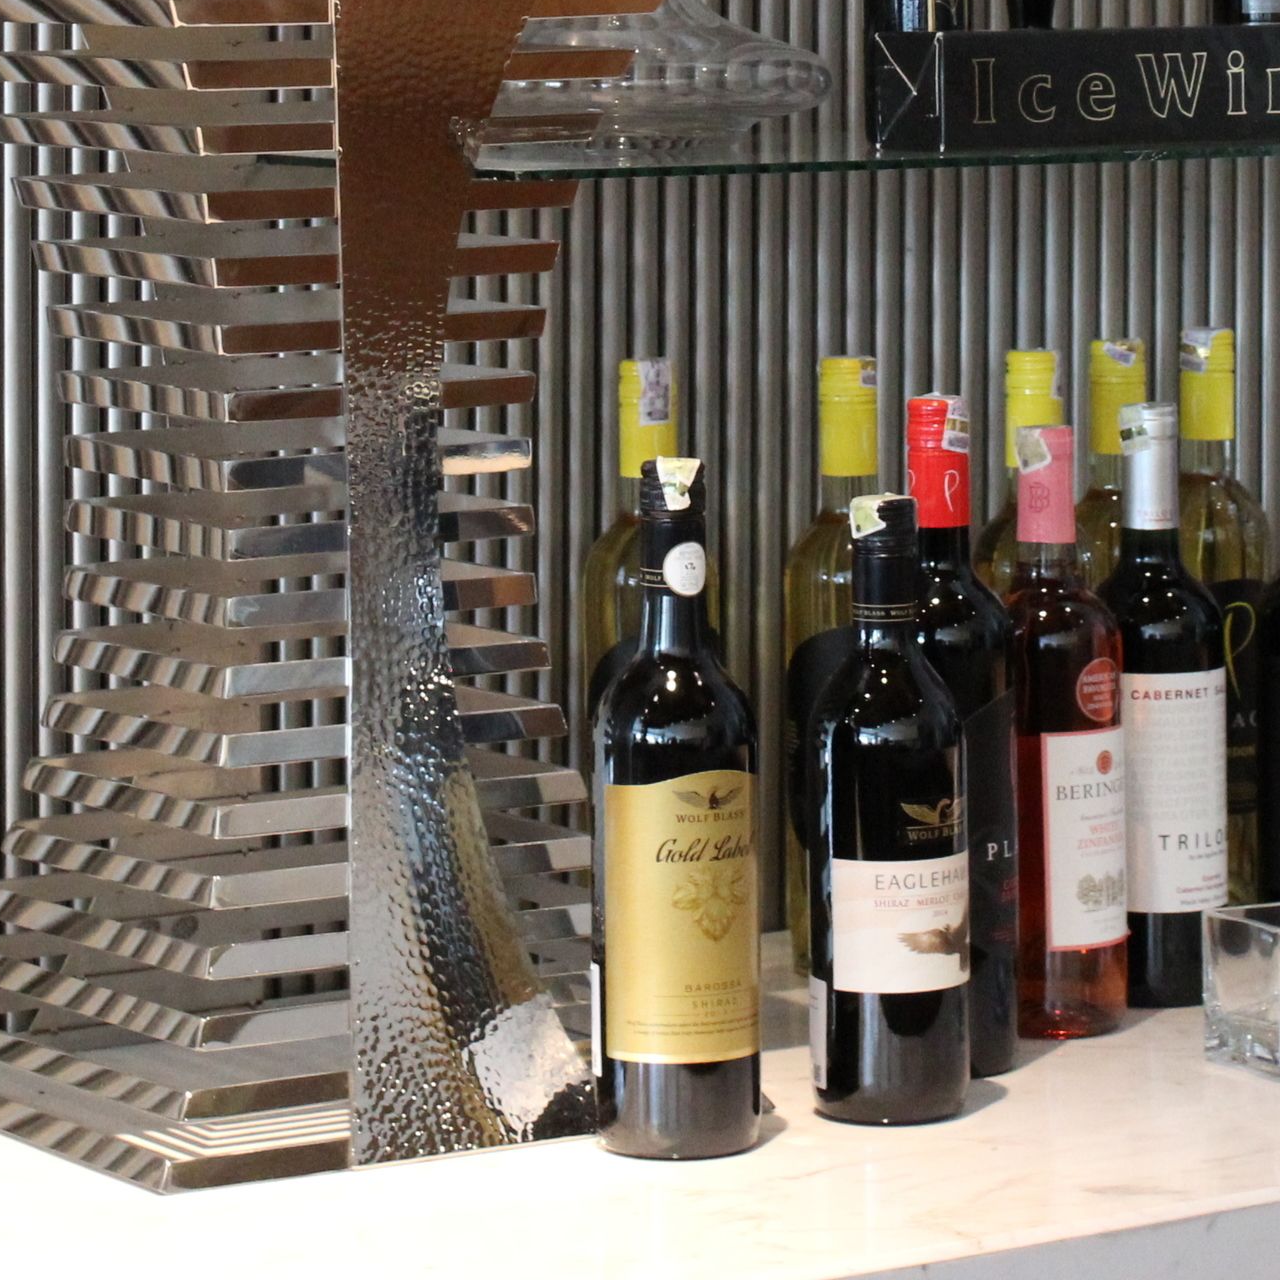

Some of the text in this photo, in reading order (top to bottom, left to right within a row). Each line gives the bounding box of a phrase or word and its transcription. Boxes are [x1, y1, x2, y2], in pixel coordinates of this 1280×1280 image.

[1131, 687, 1209, 700] CABERNET
[676, 809, 745, 824] WOLF BLASS
[907, 830, 939, 840] WOLF
[656, 837, 710, 863] Gold
[874, 900, 909, 908] SHIRAZ
[684, 980, 742, 993] BAROSSA
[691, 998, 737, 1009] SHIRAZ
